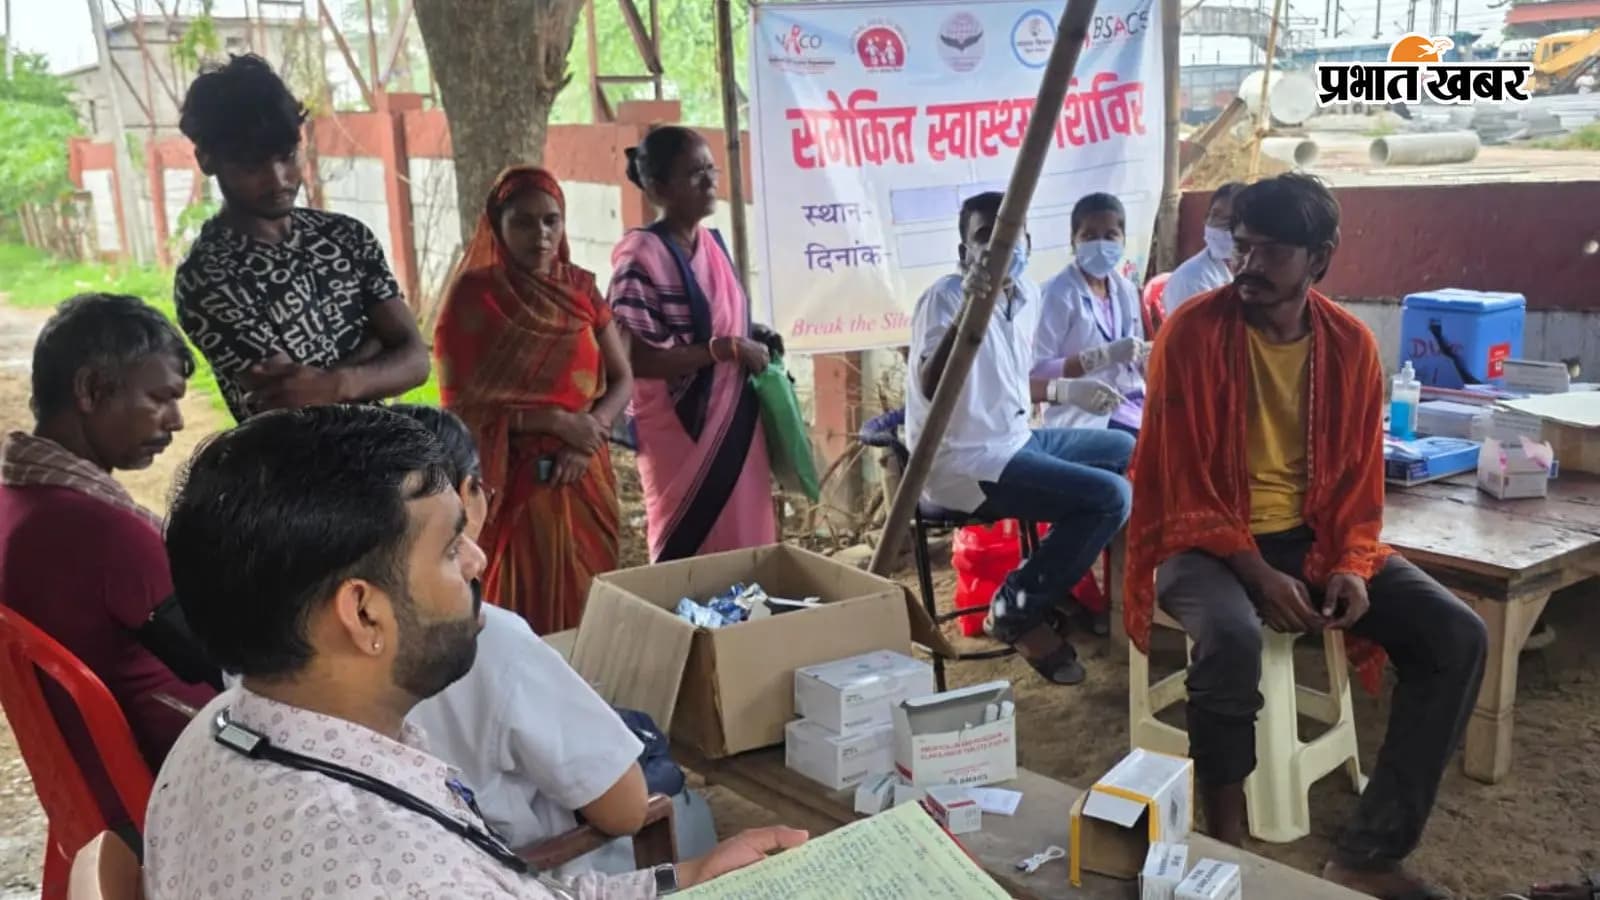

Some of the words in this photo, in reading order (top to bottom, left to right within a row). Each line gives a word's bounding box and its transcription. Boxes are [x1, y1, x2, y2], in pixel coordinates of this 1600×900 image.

[1093, 11, 1149, 39] BSACS
[786, 88, 918, 169] समेकित
[792, 316, 842, 337] Break
[849, 313, 877, 334] the
